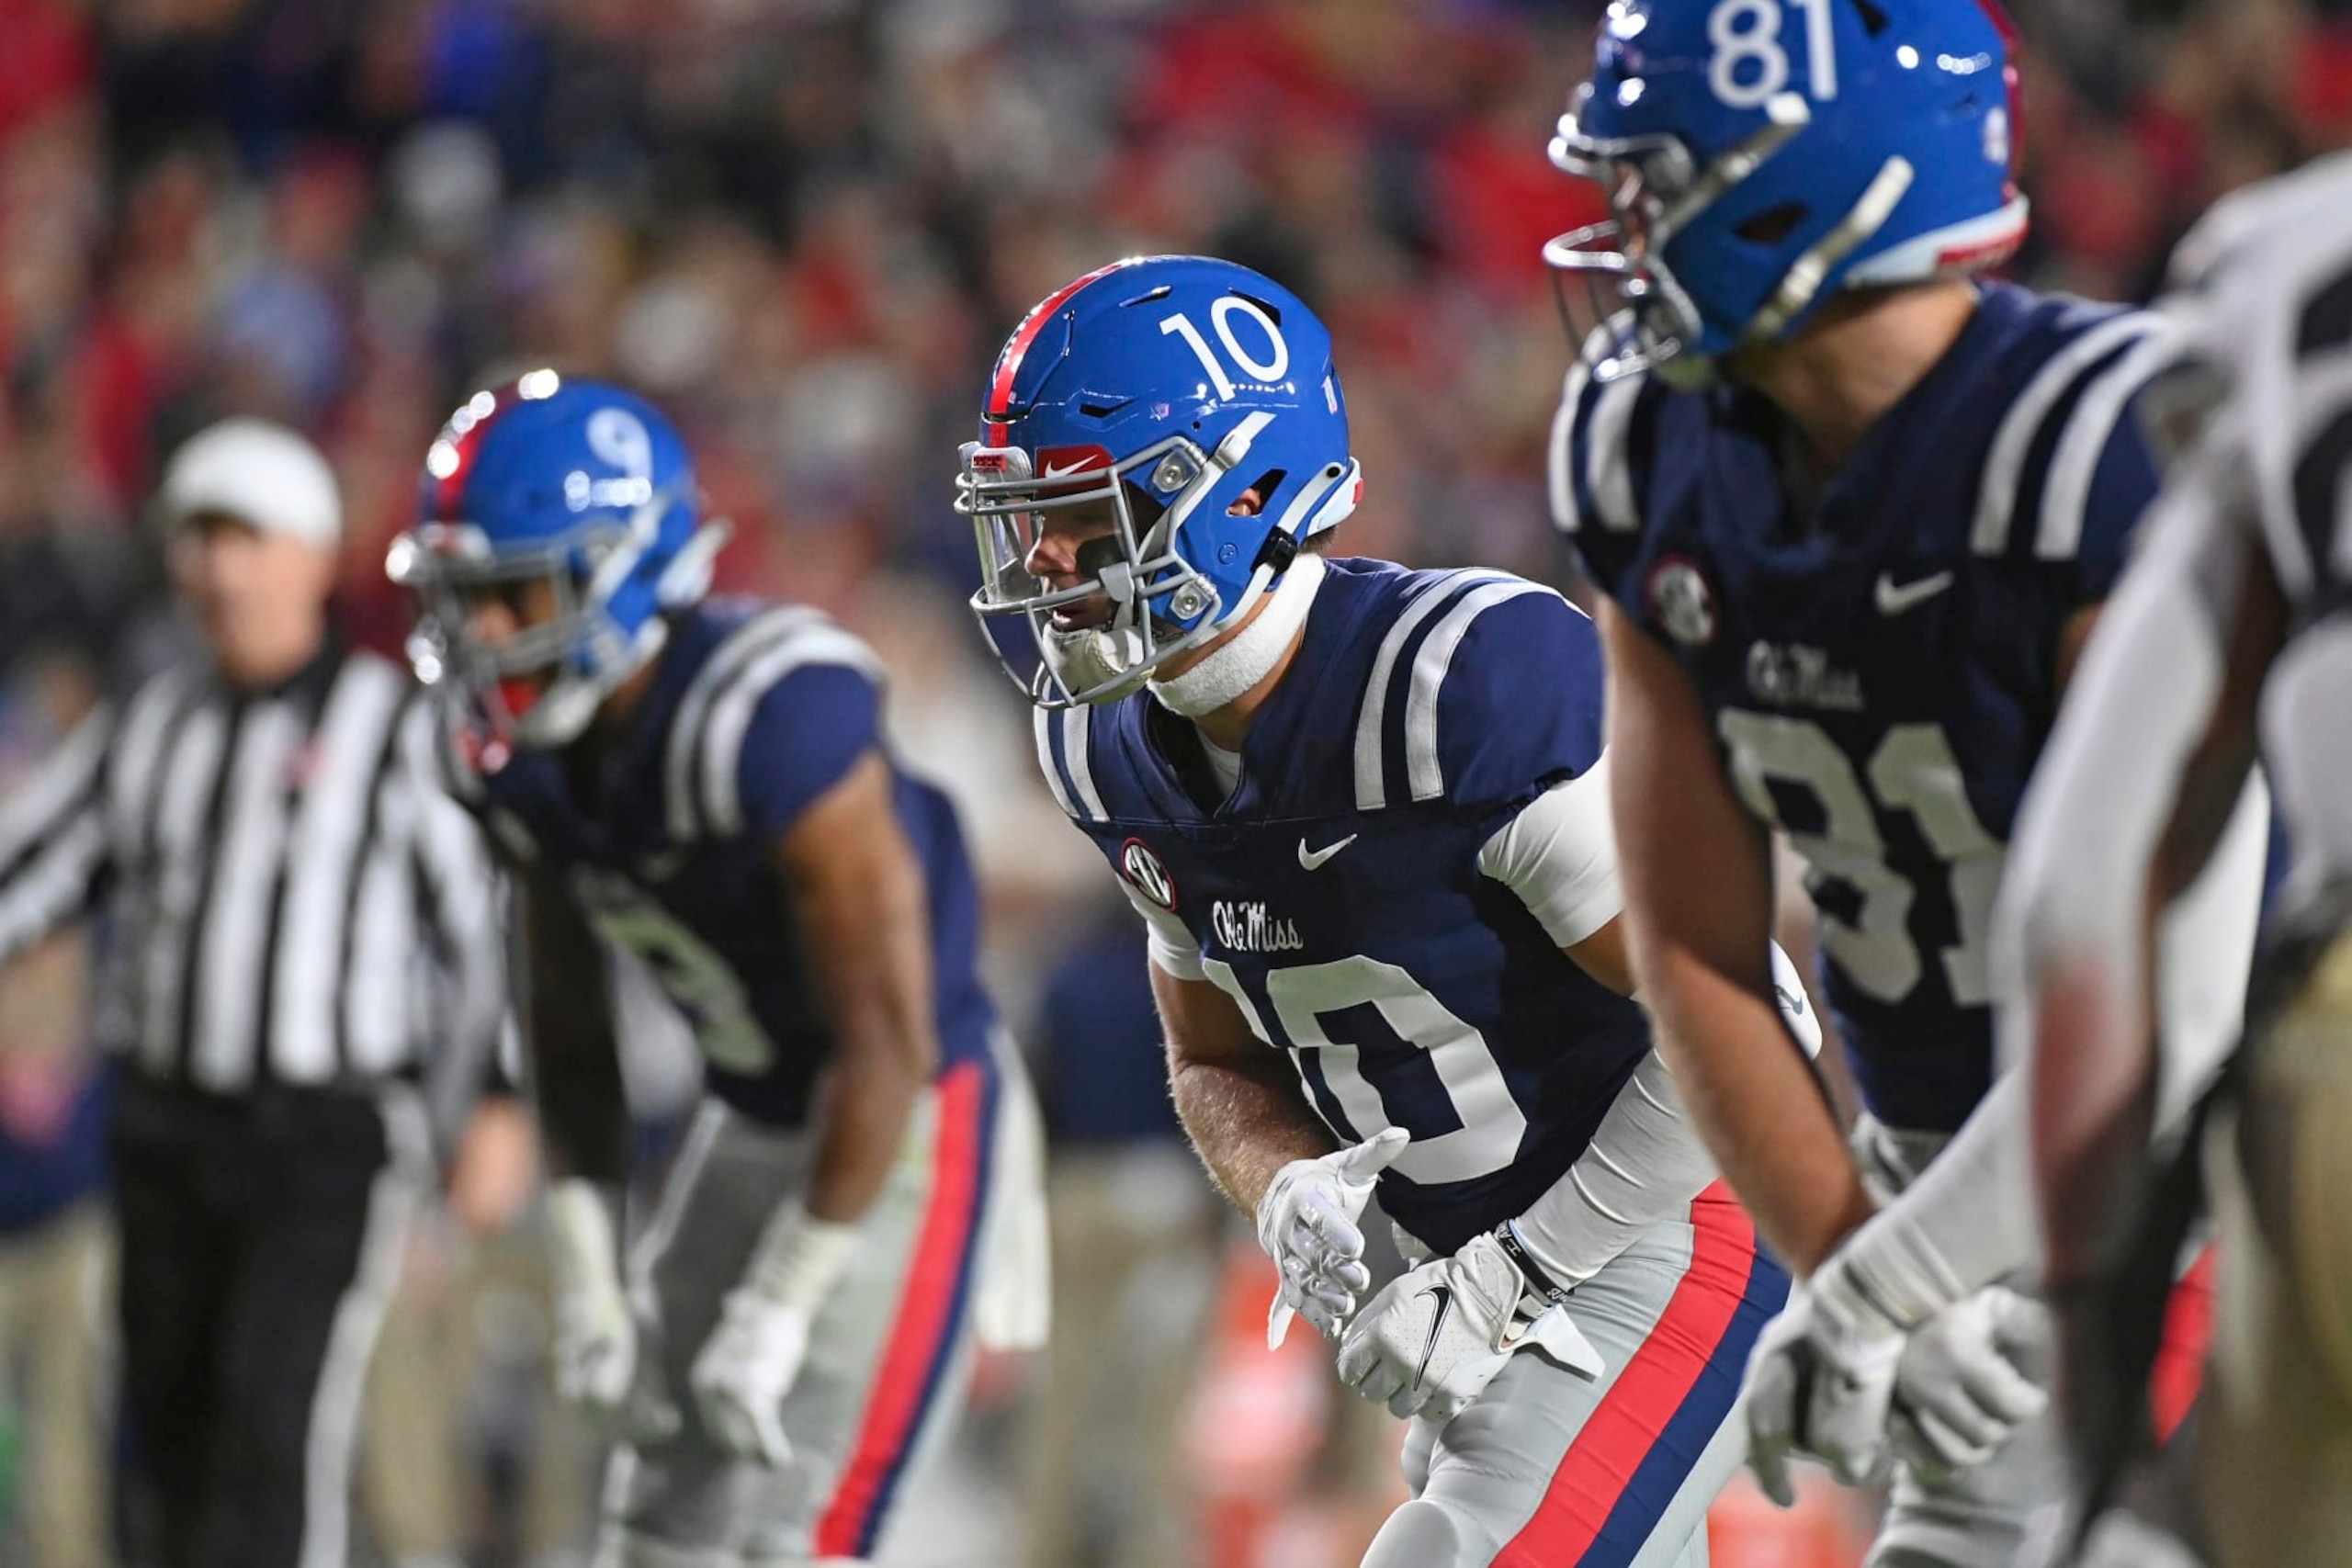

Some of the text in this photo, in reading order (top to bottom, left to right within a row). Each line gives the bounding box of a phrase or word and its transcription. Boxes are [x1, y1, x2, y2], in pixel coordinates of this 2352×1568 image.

[1708, 0, 1838, 107] 81
[1159, 296, 1289, 401] 10
[586, 408, 652, 503] 9
[1716, 706, 2007, 1007] 81
[1213, 899, 1304, 953] Ole Miss
[1201, 954, 1528, 1185] 10
